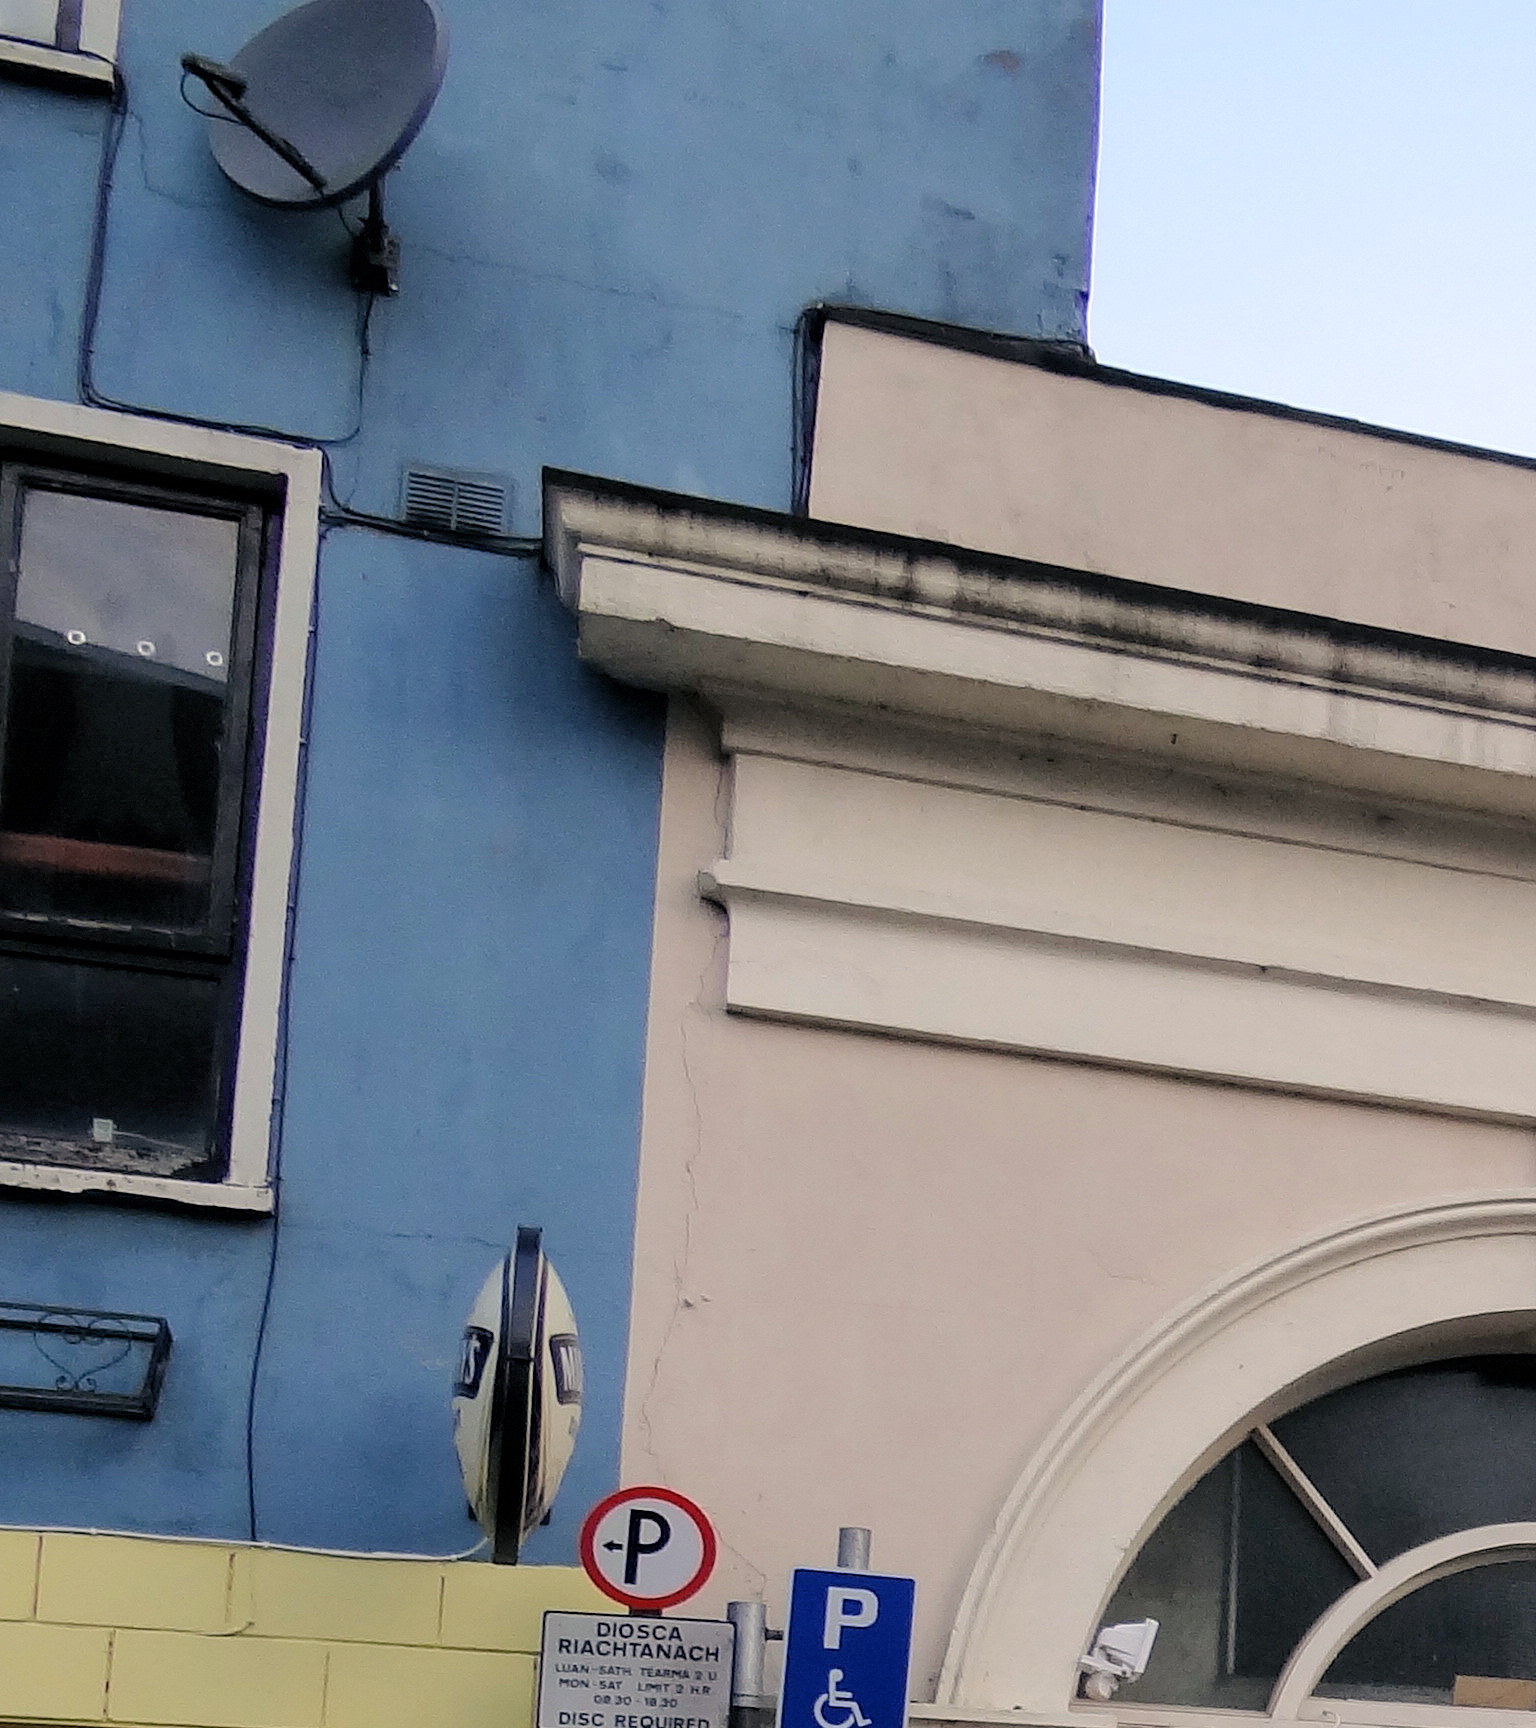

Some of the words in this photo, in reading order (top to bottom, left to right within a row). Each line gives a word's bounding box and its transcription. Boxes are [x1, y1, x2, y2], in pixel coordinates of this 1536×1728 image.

[623, 1508, 671, 1585] P
[823, 1586, 880, 1650] P
[597, 1622, 683, 1643] DIOSCA
[558, 1638, 720, 1663] RIACHTANACH
[558, 1711, 605, 1728] DISC
